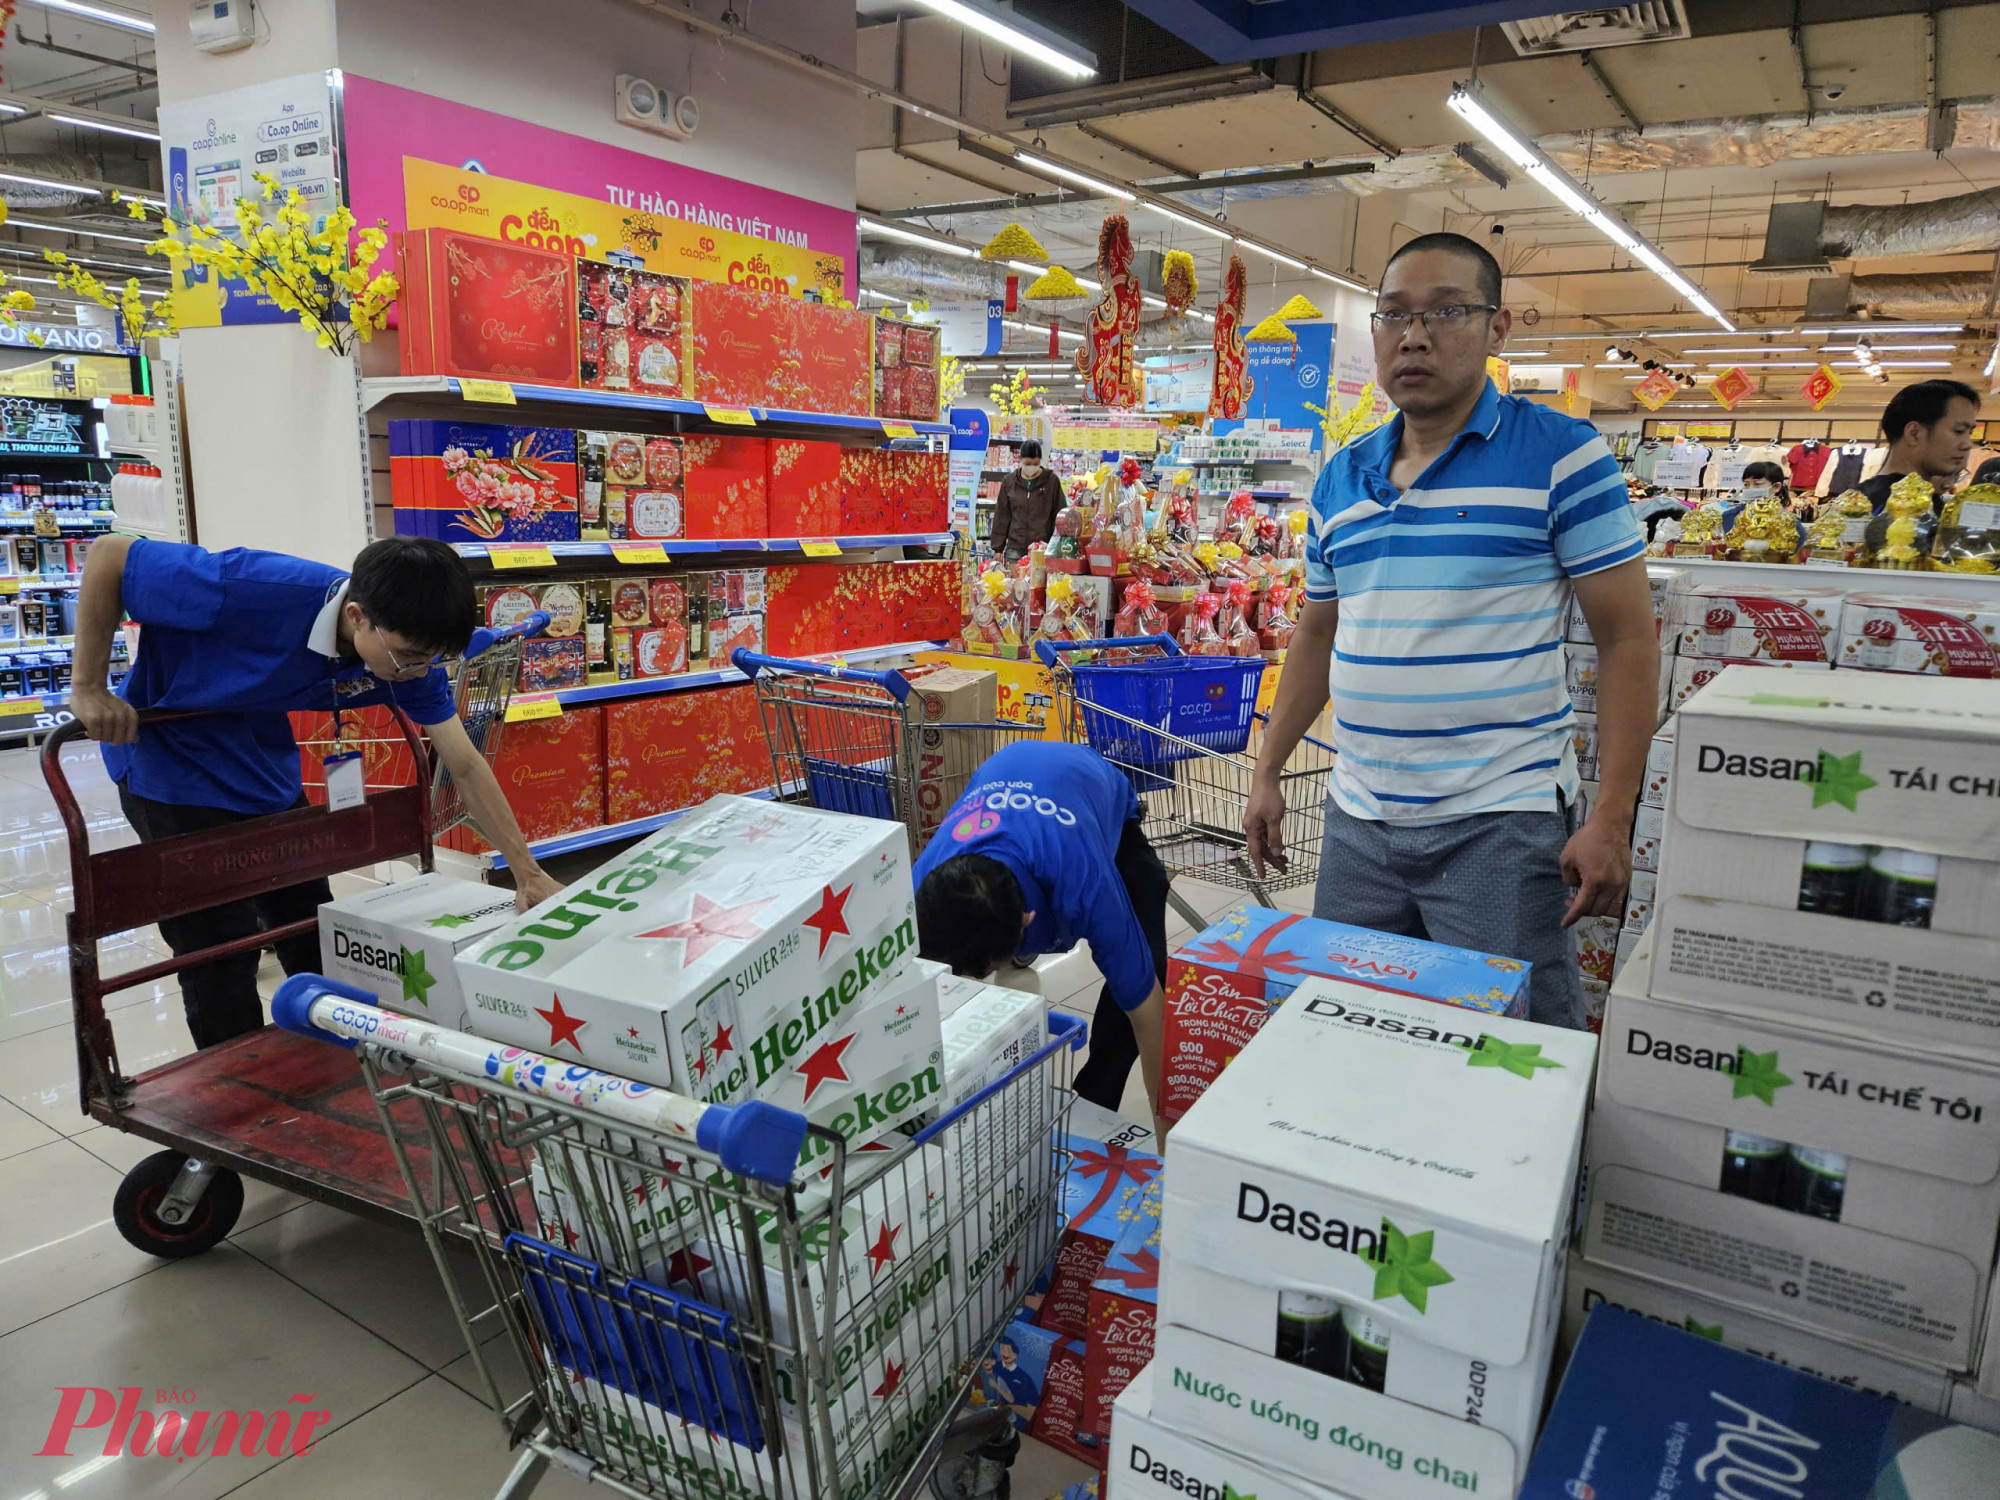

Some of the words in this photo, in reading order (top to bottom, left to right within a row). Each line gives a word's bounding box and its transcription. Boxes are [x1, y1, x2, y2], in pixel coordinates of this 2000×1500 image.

[292, 117, 319, 132] Online
[281, 167, 306, 178] Website
[528, 207, 560, 232] đến
[640, 191, 680, 219] HÀO
[684, 202, 732, 232] HÀNG
[775, 228, 808, 249] NAM
[748, 253, 770, 275] đến
[988, 306, 1002, 318] 03
[482, 319, 526, 344] Royal
[719, 330, 762, 350] Premium
[812, 346, 846, 364] Premium
[1259, 343, 1280, 354] thông
[1282, 344, 1302, 353] mih,
[1272, 356, 1290, 366] dàng
[450, 427, 488, 446] Spring
[1281, 440, 1306, 448] Select
[550, 603, 574, 612] Werther's
[1706, 606, 1732, 623] 333
[1764, 607, 1806, 627] TẾT
[1864, 619, 1893, 636] 333
[1928, 620, 1975, 642] TẾT
[555, 655, 570, 668] BON
[642, 744, 687, 765] Premium
[1698, 744, 1826, 784] Dasani
[512, 765, 566, 787] Premium
[982, 780, 1006, 791] của
[1007, 780, 1034, 791] bạn
[1890, 768, 1941, 794] TÁI
[872, 856, 898, 882] Heineken
[458, 899, 517, 922] asani
[334, 930, 406, 976] Dasani
[735, 946, 780, 997] SILVER
[779, 934, 793, 955] 24
[1186, 975, 1268, 1007] Săn
[475, 994, 508, 1016] SILVER
[750, 918, 916, 1089] Heineken
[1168, 992, 1200, 1016] Lời
[1316, 994, 1344, 1004] Nước
[1348, 1002, 1376, 1012] uống
[1379, 1008, 1408, 1019] đóng
[1411, 1014, 1436, 1024] chai
[884, 1010, 920, 1033] Heineken
[894, 1023, 912, 1038] SILVER
[1178, 1020, 1209, 1028] TRONG
[1210, 1020, 1228, 1030] MỖI
[1230, 1025, 1254, 1042] THÙN
[1304, 999, 1488, 1051] Dasani
[1188, 1028, 1202, 1036] CƠ
[1204, 1029, 1220, 1040] HỘI
[615, 1036, 658, 1055] Heineken
[1180, 1042, 1204, 1054] 600
[1626, 1028, 1745, 1078] Dasani
[628, 1052, 649, 1064] SILVER
[1183, 1054, 1202, 1062] VÀNG
[1167, 1074, 1210, 1090] 800.000
[1804, 1071, 1848, 1096] TÁI
[1858, 1081, 1926, 1111] CHẾ
[1930, 1095, 1983, 1124] TÔI
[797, 1066, 942, 1171] neken
[1108, 1124, 1152, 1148] Das
[1237, 1182, 1389, 1264] Dasani
[1062, 1280, 1079, 1288] 600
[836, 1252, 949, 1377] eineken
[1853, 1307, 1906, 1328] COCA-COLA
[1908, 1323, 1954, 1343] COMPANY
[1096, 1324, 1124, 1344] Lời
[1116, 1354, 1128, 1362] CƠ
[1130, 1356, 1145, 1366] HỘI
[1108, 1366, 1130, 1378] 600
[1051, 1394, 1068, 1406] 600
[1174, 1367, 1242, 1409] Nước
[1250, 1396, 1320, 1442] uống
[1330, 1424, 1404, 1471] đóng
[1414, 1454, 1480, 1494] chai
